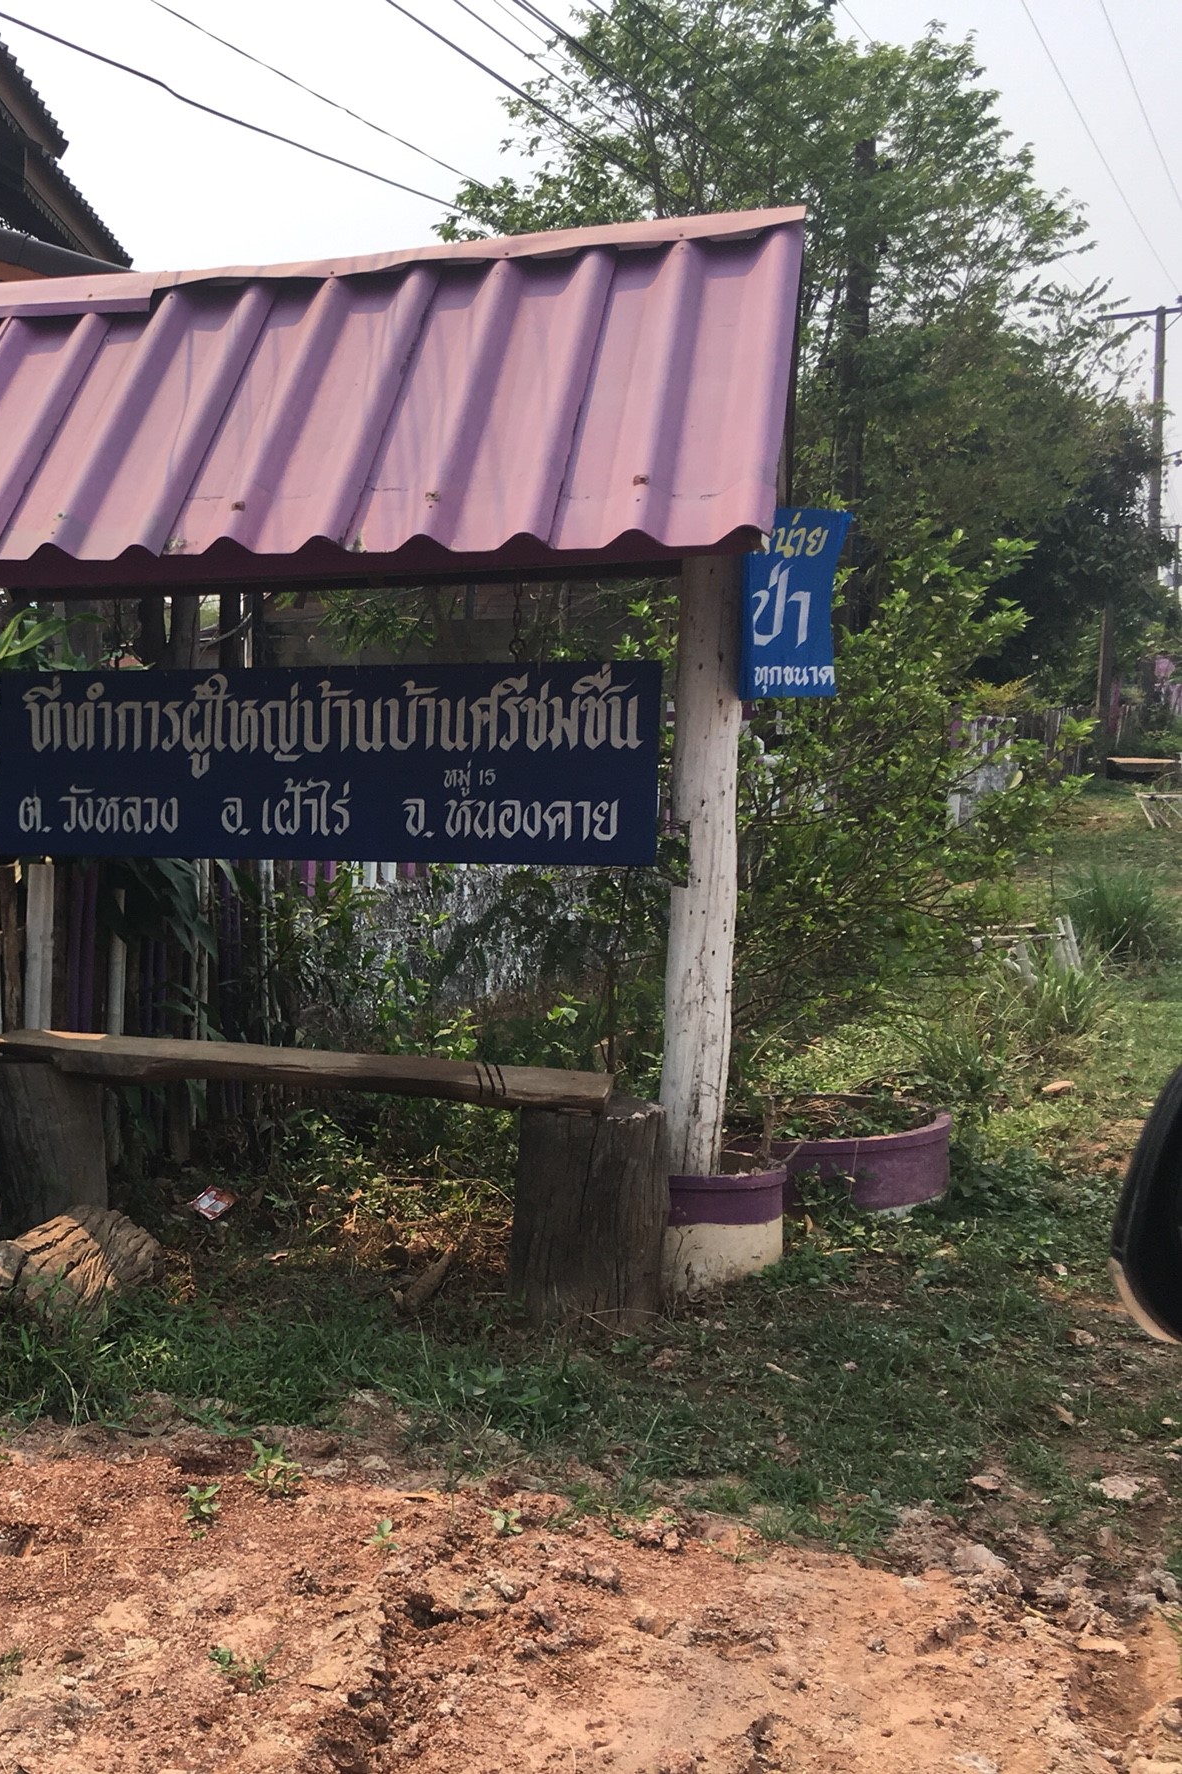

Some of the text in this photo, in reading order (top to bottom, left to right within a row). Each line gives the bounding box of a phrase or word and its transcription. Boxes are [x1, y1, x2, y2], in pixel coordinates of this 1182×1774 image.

[754, 665, 836, 696] ทุกขนาด
[443, 760, 497, 797] หมู่ 15
[18, 776, 620, 842] ต. วังหลวง อ. เฝ้าไร่ จ. หนองคาย
